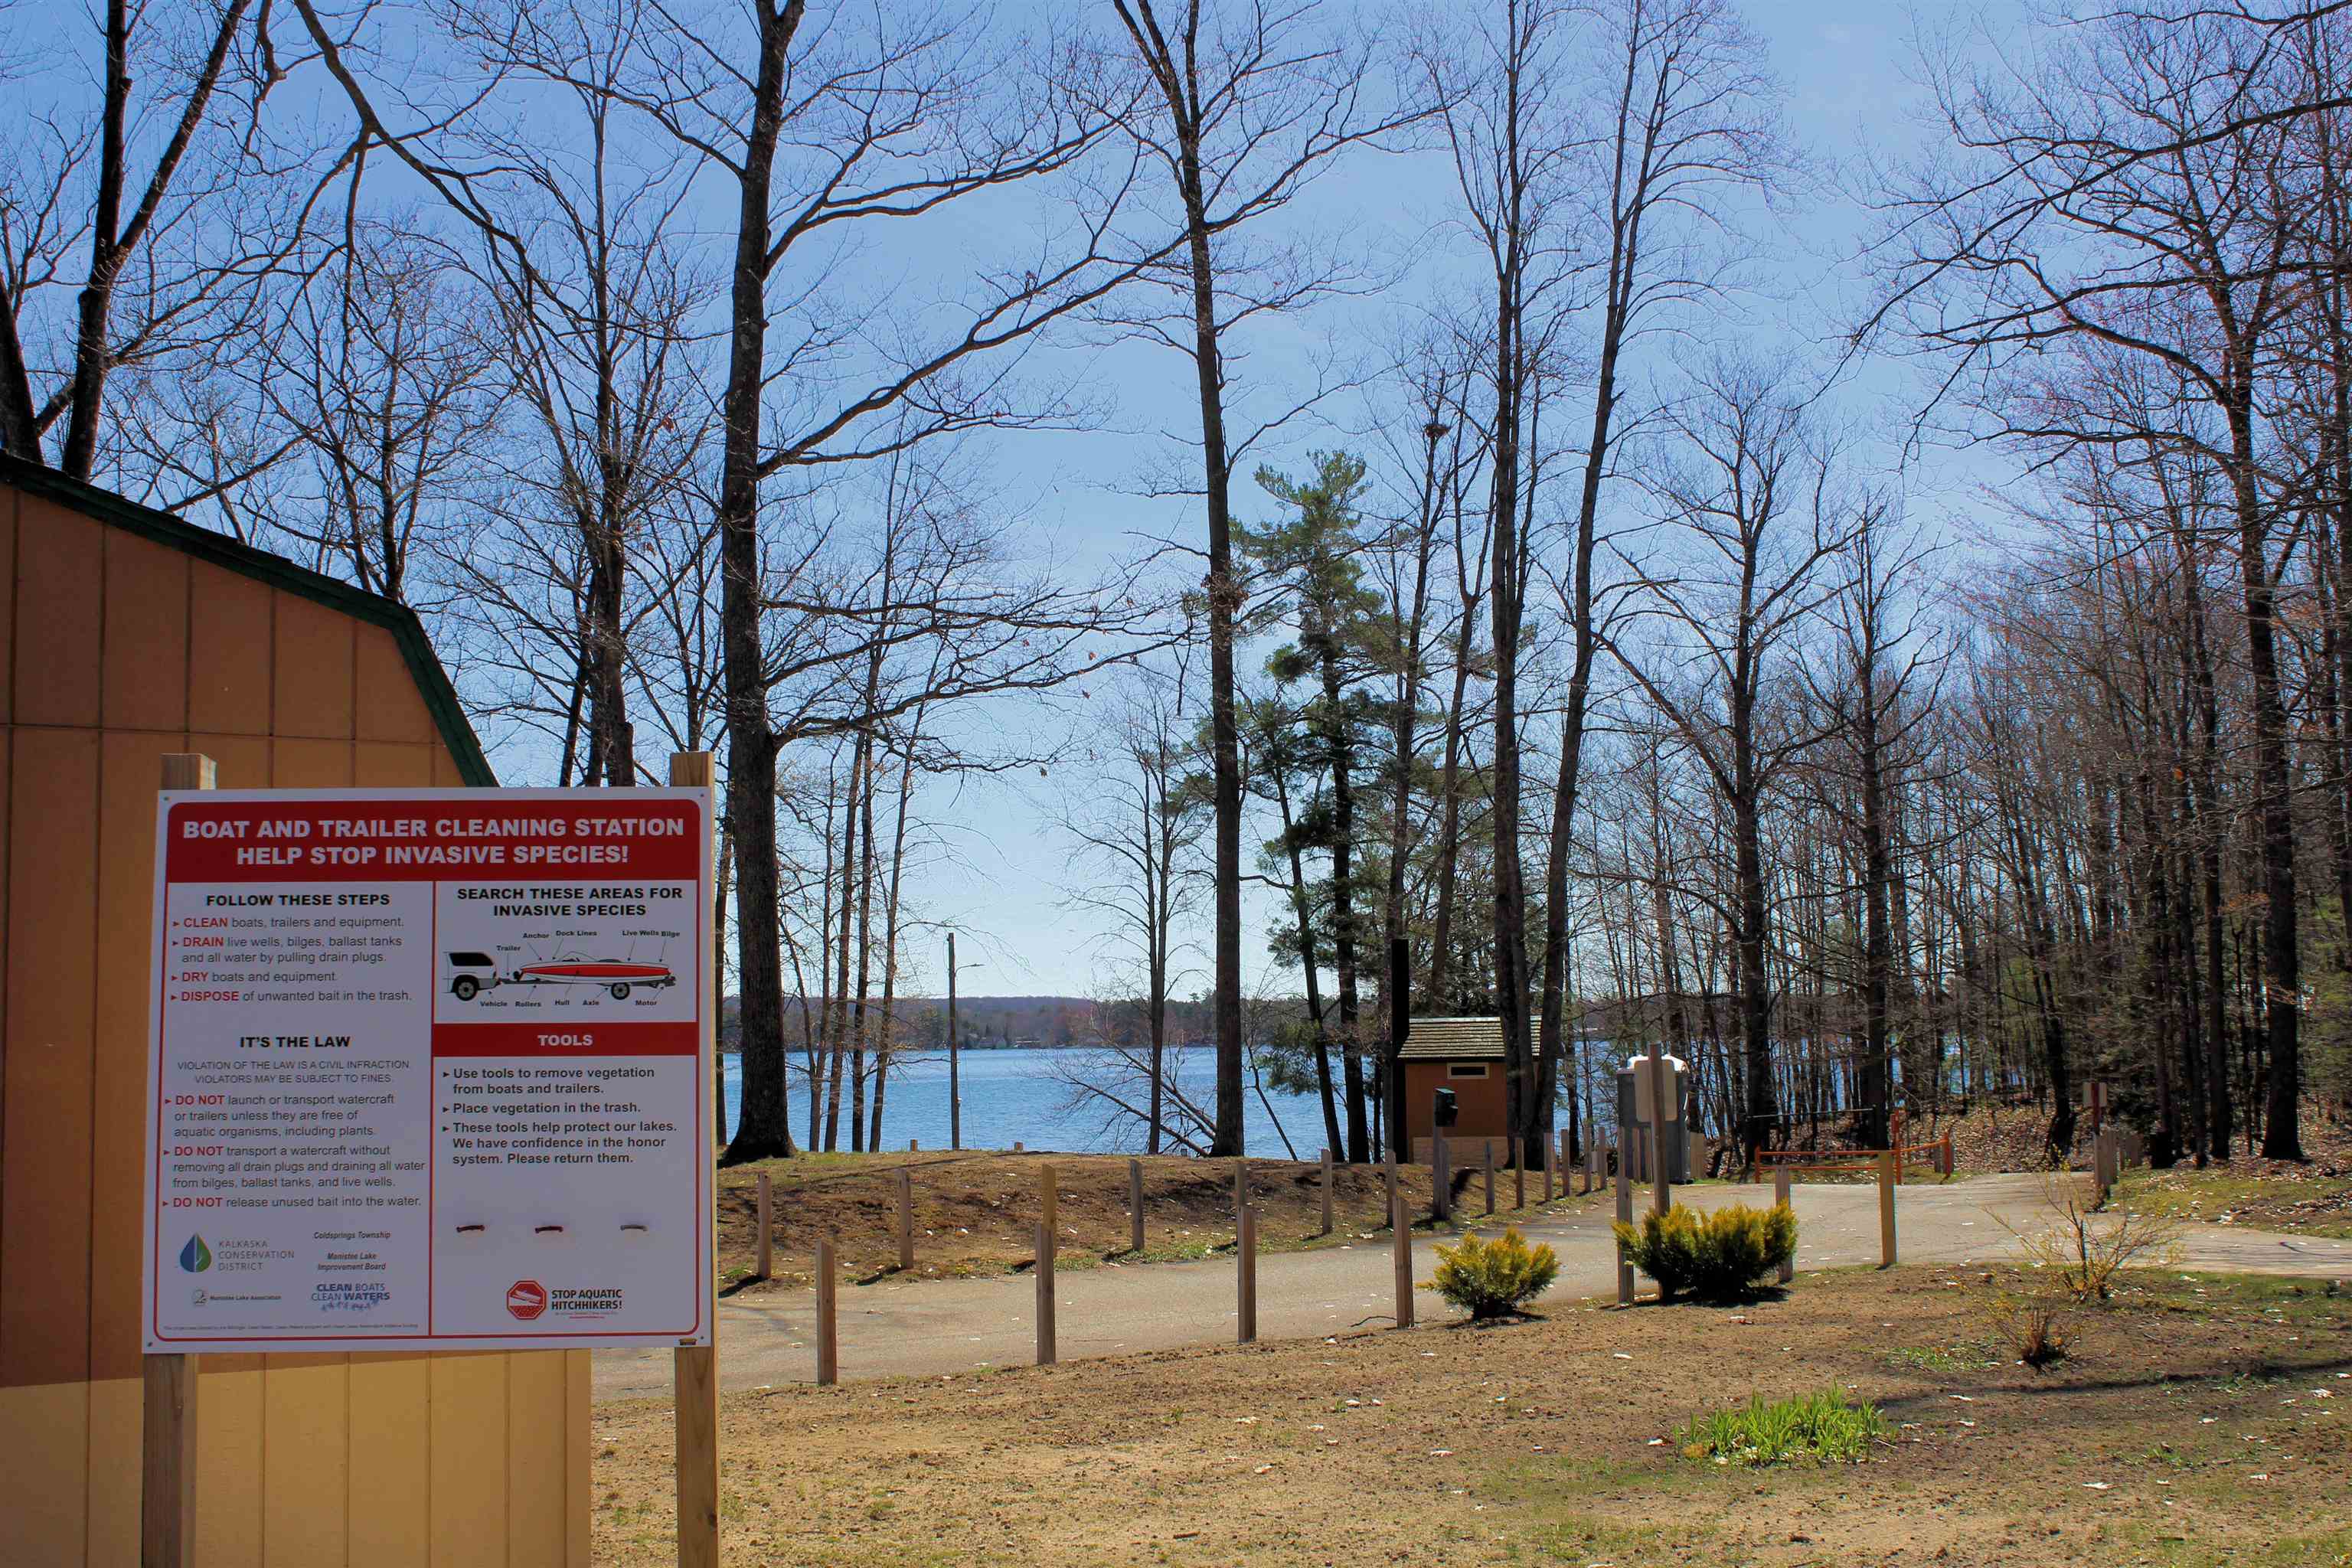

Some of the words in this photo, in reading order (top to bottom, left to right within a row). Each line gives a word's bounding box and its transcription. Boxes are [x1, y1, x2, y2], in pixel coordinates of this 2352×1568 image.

[183, 821, 251, 838] BOAT
[257, 821, 309, 838] AND
[317, 820, 426, 837] TRAILER
[436, 819, 566, 836] CLEANING
[574, 818, 684, 836] STATION
[237, 848, 302, 864] HELP
[310, 847, 377, 864] STOP
[385, 846, 504, 864] INVASIVE
[513, 845, 629, 863] SPECIES!
[207, 895, 273, 906] FOLLOW
[279, 895, 332, 905] THESE
[338, 894, 390, 905] STEPS
[458, 889, 524, 900] SEARCH
[530, 888, 583, 899] THESE
[590, 888, 644, 899] AREAS
[650, 888, 682, 898] FOR
[494, 905, 570, 916] INVASIVE
[577, 905, 645, 916] SPECIES
[184, 918, 227, 927] CLEAN
[232, 917, 267, 929] boats,
[270, 917, 309, 928] trailers
[314, 917, 335, 926] and
[339, 917, 404, 929] equipment.
[183, 937, 224, 946] DRAIN
[227, 937, 247, 946] live
[250, 937, 283, 947] wells,
[287, 937, 325, 949] bilges,
[329, 937, 367, 946] ballast
[371, 936, 402, 946] tanks
[182, 953, 204, 962] and
[207, 952, 220, 962] all
[224, 952, 256, 962] water
[260, 952, 273, 964] by
[277, 952, 315, 964] pulling
[319, 952, 348, 962] drain
[352, 952, 387, 964] plugs.
[182, 972, 208, 982] DRY
[212, 972, 244, 982] boats
[248, 972, 270, 982] and
[181, 991, 239, 1001] DISPOSE
[243, 991, 254, 1001] of
[257, 991, 314, 1001] unwanted
[318, 991, 339, 1001] bait
[344, 991, 353, 1000] in
[357, 991, 375, 1000] the
[379, 990, 412, 1000] trash.
[240, 1037, 270, 1047] IT'S
[276, 1037, 309, 1047] THE
[315, 1037, 350, 1047] LAW
[537, 1035, 593, 1046] TOOLS
[453, 1069, 478, 1078] Use
[482, 1068, 514, 1078] tools
[518, 1069, 531, 1078] to
[535, 1068, 583, 1078] remove
[587, 1067, 654, 1080] vegetation
[453, 1084, 483, 1094] from
[487, 1084, 523, 1093] boats
[527, 1083, 551, 1093] and
[555, 1083, 603, 1093] trailers.
[175, 1095, 194, 1105] DO
[198, 1095, 224, 1105] NOT
[227, 1096, 265, 1106] launch
[284, 1095, 334, 1106] transport
[338, 1094, 395, 1104] watercraft
[453, 1103, 488, 1113] Place
[492, 1102, 560, 1116] vegetation
[564, 1102, 576, 1112] in
[580, 1102, 600, 1112] the
[605, 1102, 641, 1113] trash.
[189, 1111, 227, 1121] trailers
[232, 1111, 268, 1121] unless
[272, 1111, 295, 1122] they
[299, 1112, 318, 1121] are
[322, 1110, 343, 1120] free
[347, 1110, 358, 1119] of
[174, 1127, 215, 1138] aquatic
[219, 1127, 282, 1139] organisms,
[285, 1126, 335, 1139] including
[453, 1122, 492, 1132] These
[496, 1122, 528, 1133] tools
[532, 1122, 560, 1134] help
[564, 1122, 610, 1134] protect
[614, 1122, 635, 1131] our
[640, 1121, 677, 1131] lakes.
[452, 1138, 472, 1148] We
[477, 1138, 508, 1148] have
[511, 1138, 583, 1148] confidence
[588, 1137, 599, 1147] in
[603, 1137, 623, 1147] the
[628, 1137, 666, 1147] honor
[175, 1146, 193, 1156] DO
[197, 1146, 224, 1156] NOT
[227, 1145, 277, 1158] transport
[290, 1145, 346, 1158] watercraft
[350, 1145, 390, 1155] without
[452, 1155, 503, 1166] system.
[508, 1154, 550, 1164] Please
[554, 1154, 593, 1163] return
[597, 1153, 633, 1163] them.
[173, 1163, 224, 1174] removing
[227, 1162, 240, 1171] all
[243, 1161, 271, 1171] drain
[275, 1161, 304, 1174] plugs
[308, 1161, 328, 1171] and
[332, 1161, 376, 1173] draining
[380, 1161, 391, 1170] all
[395, 1161, 425, 1170] water
[172, 1176, 198, 1188] from
[202, 1176, 237, 1190] bilges,
[241, 1176, 277, 1188] ballast
[318, 1178, 338, 1187] and
[342, 1177, 361, 1188] live
[364, 1176, 396, 1188] wells.
[173, 1197, 192, 1207] DO
[195, 1197, 223, 1207] NOT
[227, 1197, 268, 1207] release
[272, 1197, 314, 1207] unused
[318, 1197, 338, 1206] bait
[342, 1197, 362, 1206] into
[366, 1197, 384, 1207] the
[388, 1197, 421, 1207] water.
[358, 1231, 390, 1240] Township
[218, 1250, 294, 1259] CONSERVATION
[218, 1262, 263, 1270] DISTRICT
[364, 1263, 386, 1272] Board
[312, 1292, 342, 1301] CLEAN
[344, 1292, 390, 1301] WATERS
[552, 1290, 577, 1298] STOP
[580, 1289, 622, 1299] AQUATIC
[552, 1299, 622, 1310] HITCHHIKERS!
